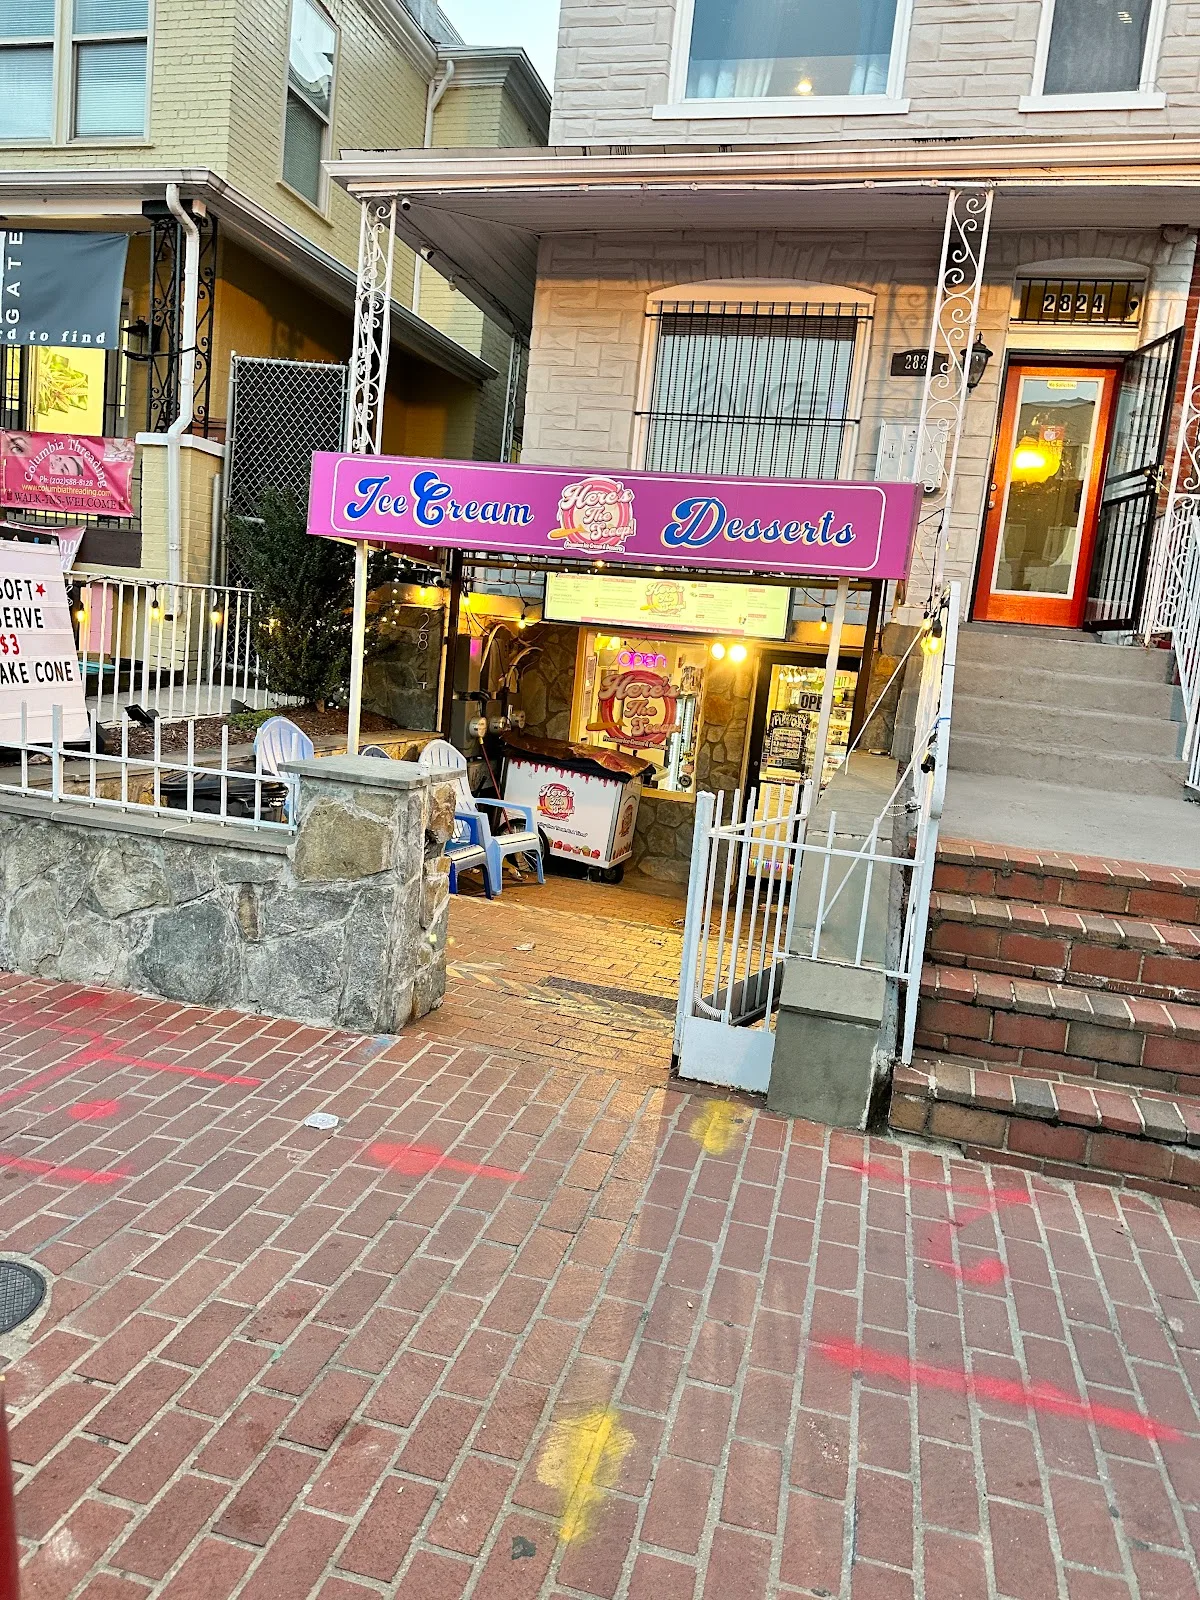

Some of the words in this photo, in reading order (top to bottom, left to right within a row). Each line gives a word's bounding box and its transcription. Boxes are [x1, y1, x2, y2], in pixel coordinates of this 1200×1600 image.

[1043, 294, 1103, 312] 2824
[29, 330, 49, 341] to
[61, 330, 106, 343] find
[905, 354, 928, 370] 282
[24, 439, 64, 482] Columbia
[68, 438, 107, 488] Threading
[39, 475, 48, 484] Ph:
[22, 484, 112, 497] www.columbiathreading.com
[343, 475, 409, 521] Ice
[410, 470, 535, 528] Cream
[560, 483, 634, 510] Here's
[14, 492, 117, 509] WALK-INS-WELCOME
[583, 506, 613, 525] The
[660, 496, 857, 549] Desserts
[0, 633, 20, 655] $3
[35, 661, 73, 682] CONE
[598, 674, 681, 700] Here's
[624, 699, 658, 718] The
[801, 694, 823, 710] OPE
